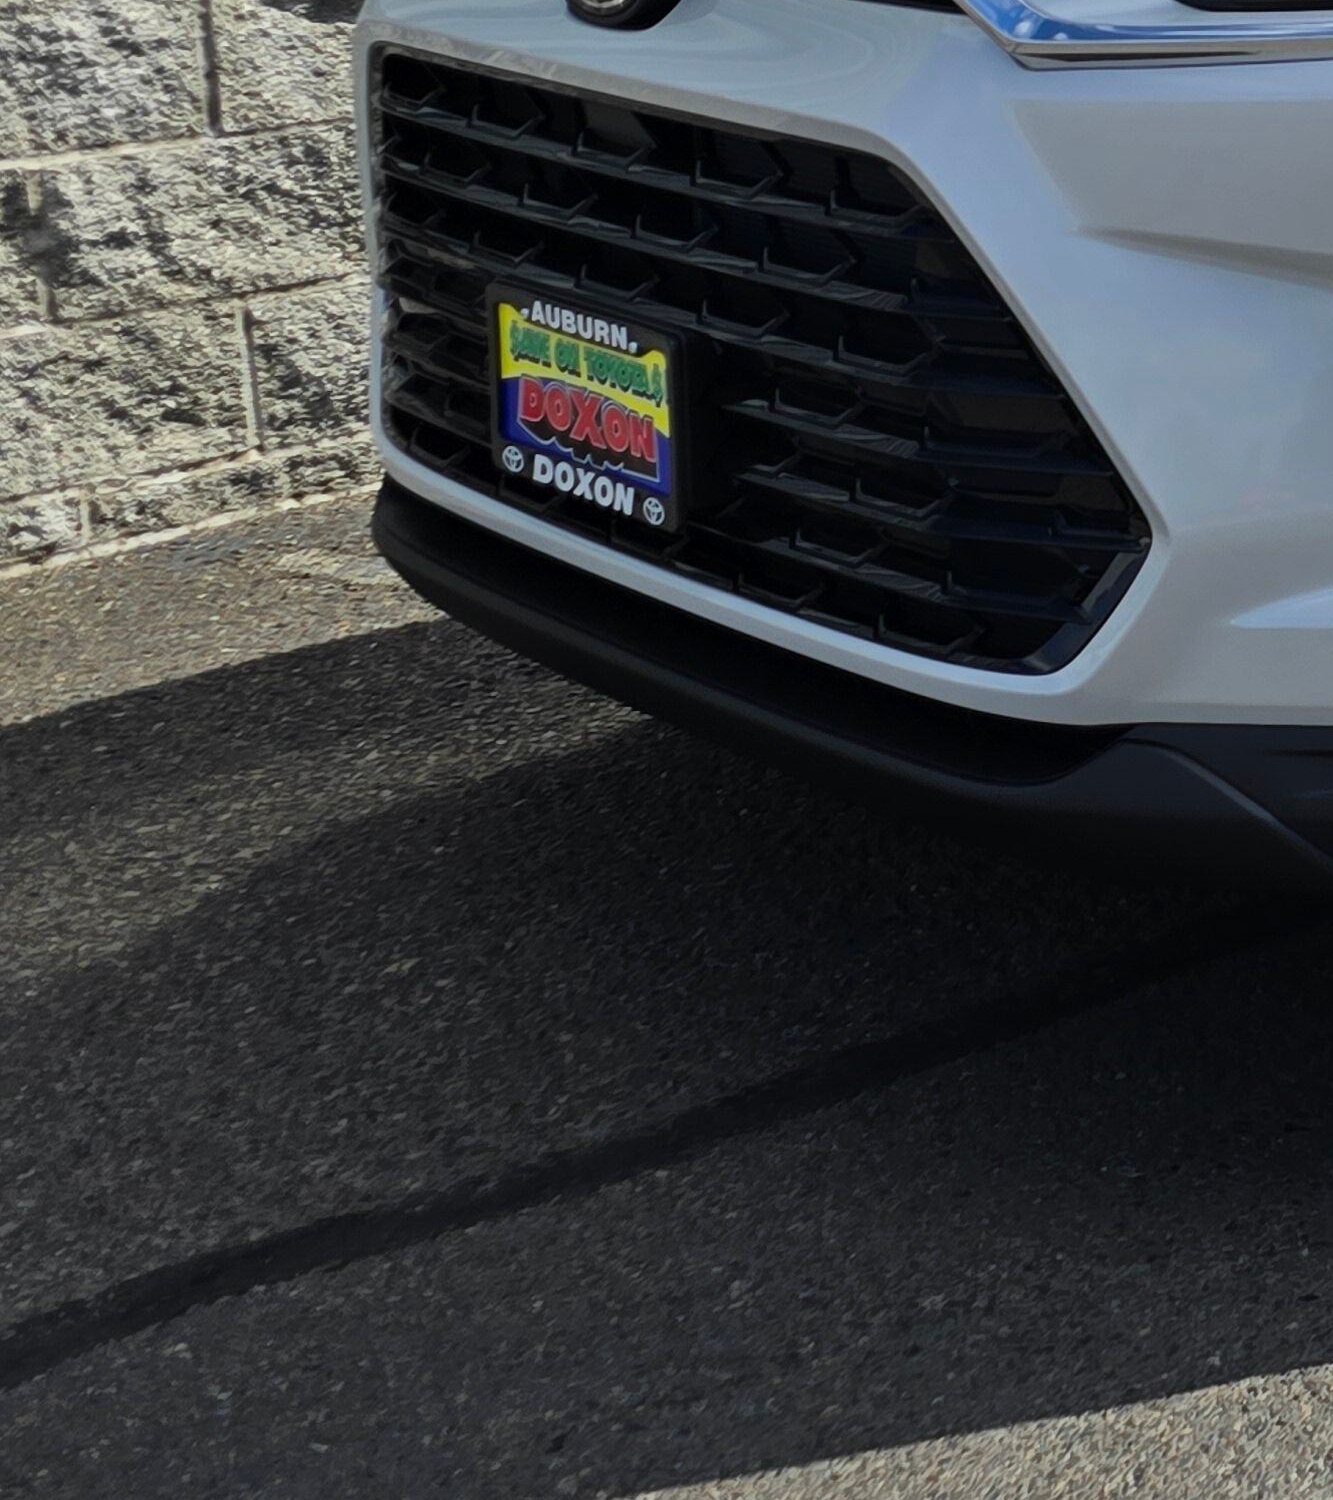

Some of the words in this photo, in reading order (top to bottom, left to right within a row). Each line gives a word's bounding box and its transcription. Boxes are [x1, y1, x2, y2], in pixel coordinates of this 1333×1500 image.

[531, 300, 628, 350] AUBURN
[518, 374, 656, 463] DOXON
[533, 454, 635, 516] DOXON
